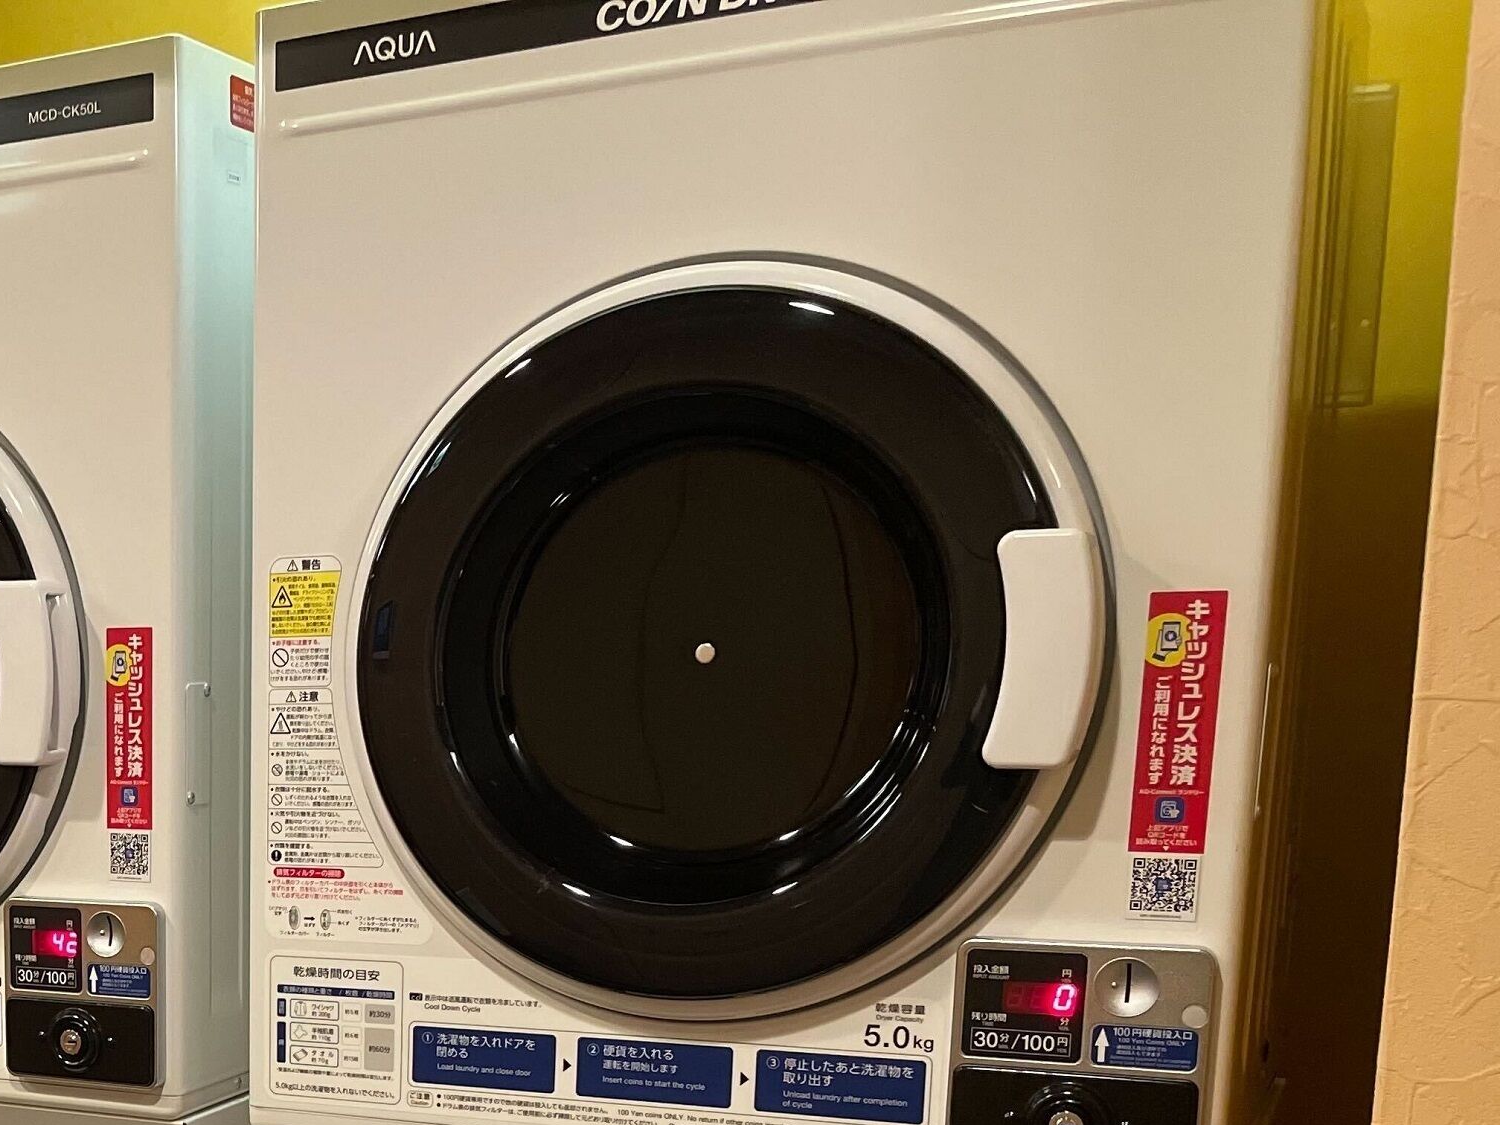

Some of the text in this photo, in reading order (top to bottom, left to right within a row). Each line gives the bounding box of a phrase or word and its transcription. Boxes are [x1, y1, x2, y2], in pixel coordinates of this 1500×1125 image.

[353, 31, 435, 65] AQUA
[28, 101, 101, 124] MCD-CK50L
[299, 691, 319, 702] 注意
[1169, 599, 1210, 786] キャッシュレス決済
[127, 633, 143, 778] キャッシュレス決済
[1148, 675, 1173, 785] ご利用になれます
[293, 966, 380, 982] 乾燥時間の目安
[973, 964, 1009, 974] 投入金額
[1061, 968, 1072, 978] 円
[1053, 983, 1077, 1011] 0
[875, 1003, 926, 1015] 乾燥容量
[971, 1011, 1007, 1023] 残り時間
[1060, 1017, 1070, 1026] 分
[436, 1033, 537, 1051] 洗濯物を入れドアを
[864, 1024, 935, 1052] 5.0kg
[436, 1047, 469, 1060] 閉める
[603, 1045, 674, 1061] 硬貨を入れる
[455, 1064, 479, 1073] laundry
[602, 1060, 678, 1074] 運転を開始します
[784, 1058, 915, 1080] 停止したあと洗濯物を
[602, 1076, 623, 1085] Insert
[625, 1078, 643, 1086] coins
[654, 1080, 671, 1089] start
[673, 1080, 684, 1090] the
[686, 1082, 706, 1092] cycle
[783, 1072, 833, 1088] 取り出す
[783, 1090, 908, 1108] Unload laundry after completion
[792, 1101, 813, 1110] cycle
[618, 1108, 629, 1116] 100
[645, 1111, 662, 1119] coins
[726, 1118, 743, 1125] other
